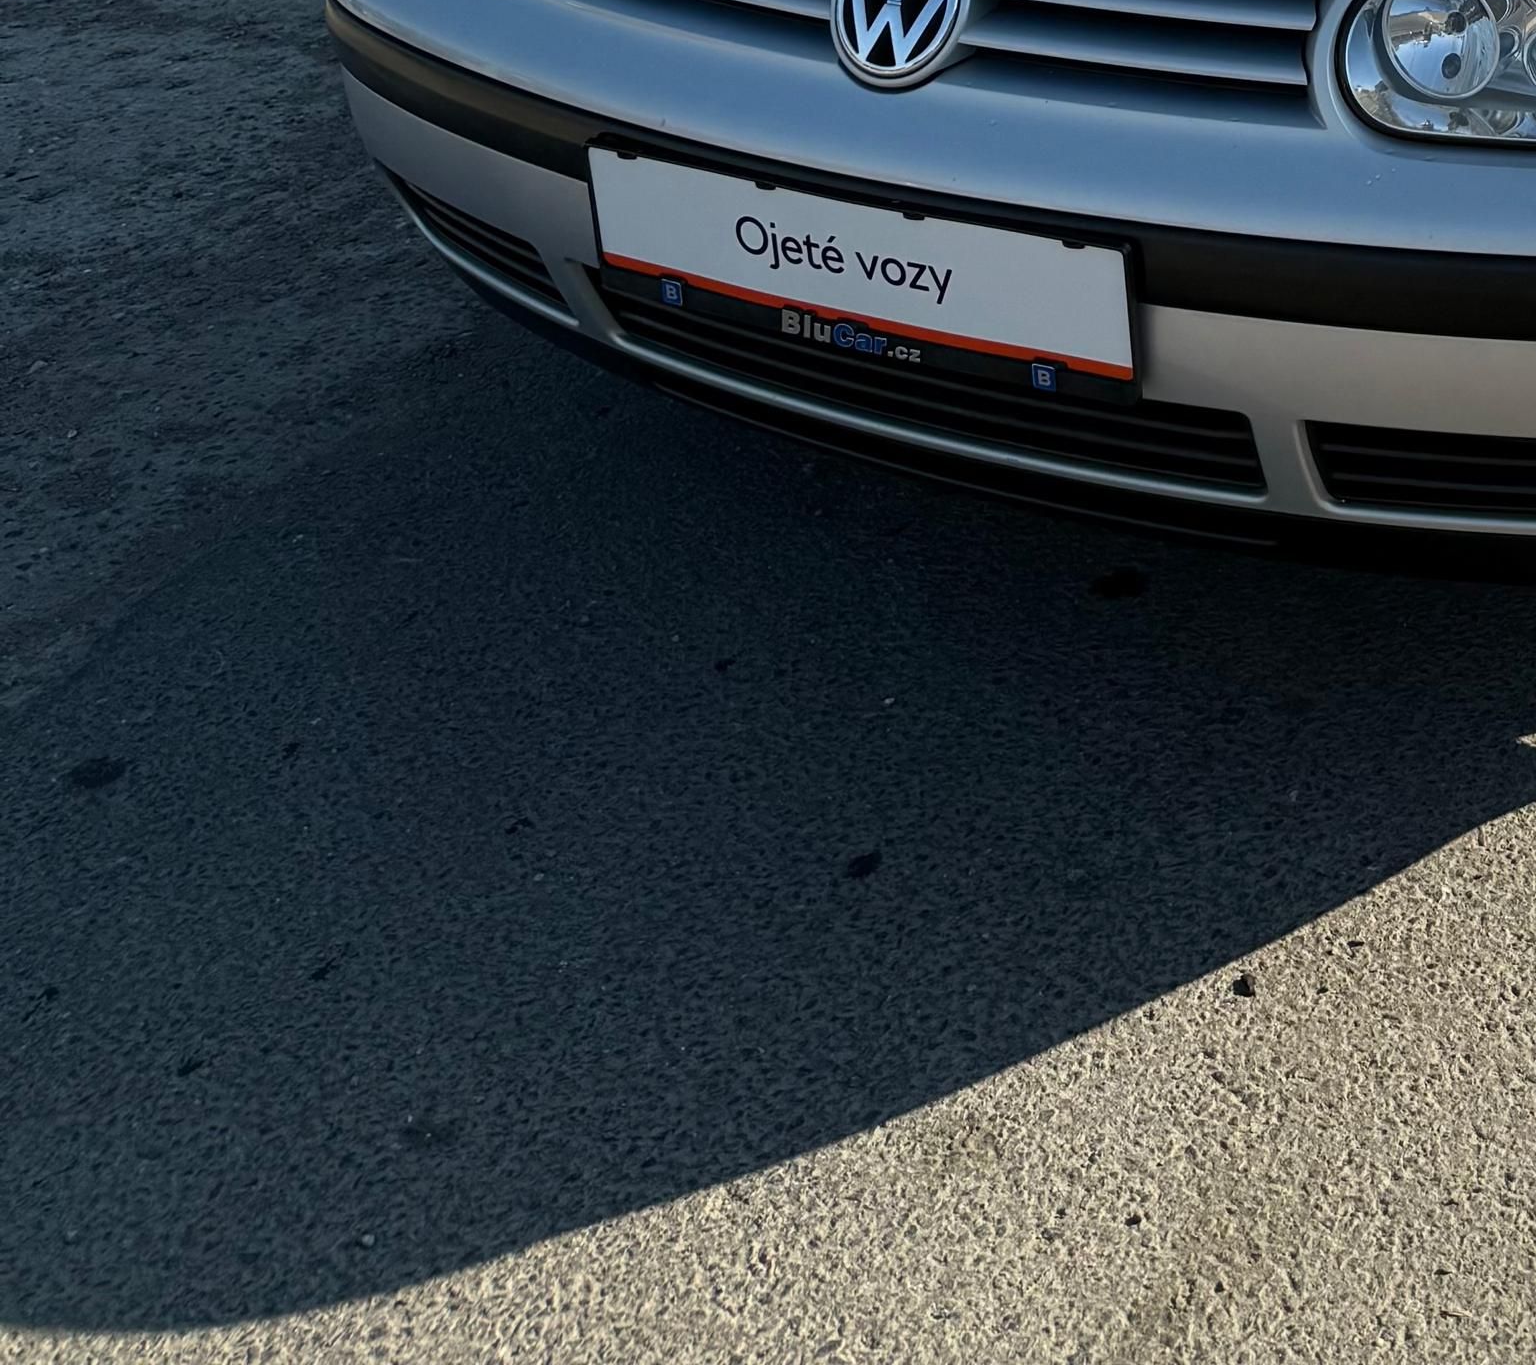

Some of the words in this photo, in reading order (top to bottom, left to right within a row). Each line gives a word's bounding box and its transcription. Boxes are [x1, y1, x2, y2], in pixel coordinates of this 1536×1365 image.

[735, 215, 845, 274] Ojeté
[855, 251, 953, 305] vozy
[781, 308, 921, 363] BluCar.cz
